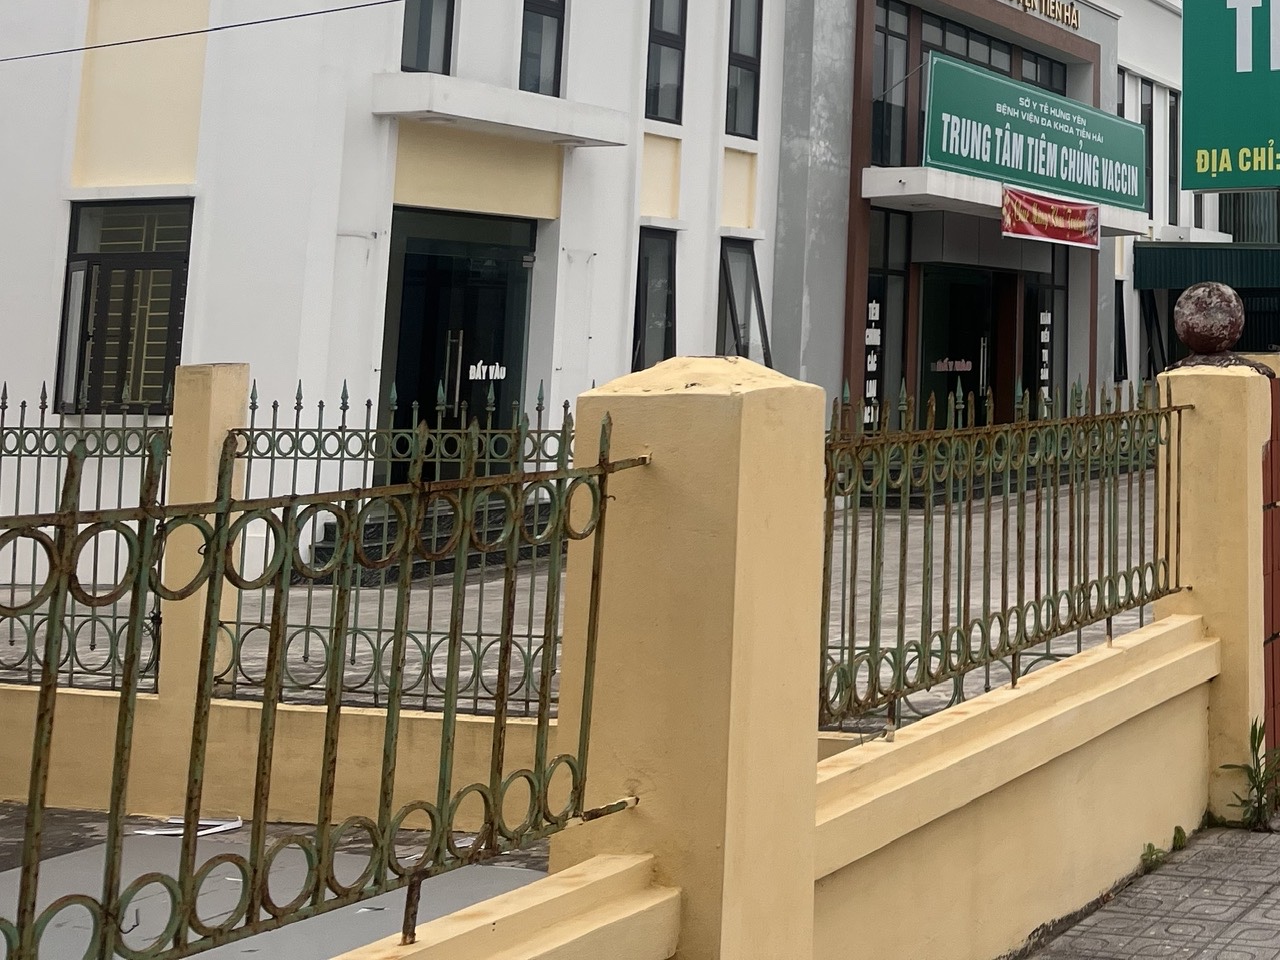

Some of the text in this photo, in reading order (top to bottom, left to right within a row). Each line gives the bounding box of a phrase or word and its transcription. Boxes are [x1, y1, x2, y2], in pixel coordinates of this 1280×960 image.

[996, 103, 1020, 119] BỆNH
[1021, 109, 1040, 125] VIỆN
[1040, 117, 1052, 128] ĐA
[1053, 121, 1074, 136] KHOA
[1018, 96, 1031, 108] SỞ
[1032, 101, 1038, 109] Y
[1050, 107, 1071, 121] HƯNG
[1071, 113, 1087, 127] YÊN
[941, 112, 1139, 197] TRUNG TÂM TIÊM CHỦNG VACCIN
[1196, 148, 1233, 178] ĐỊA
